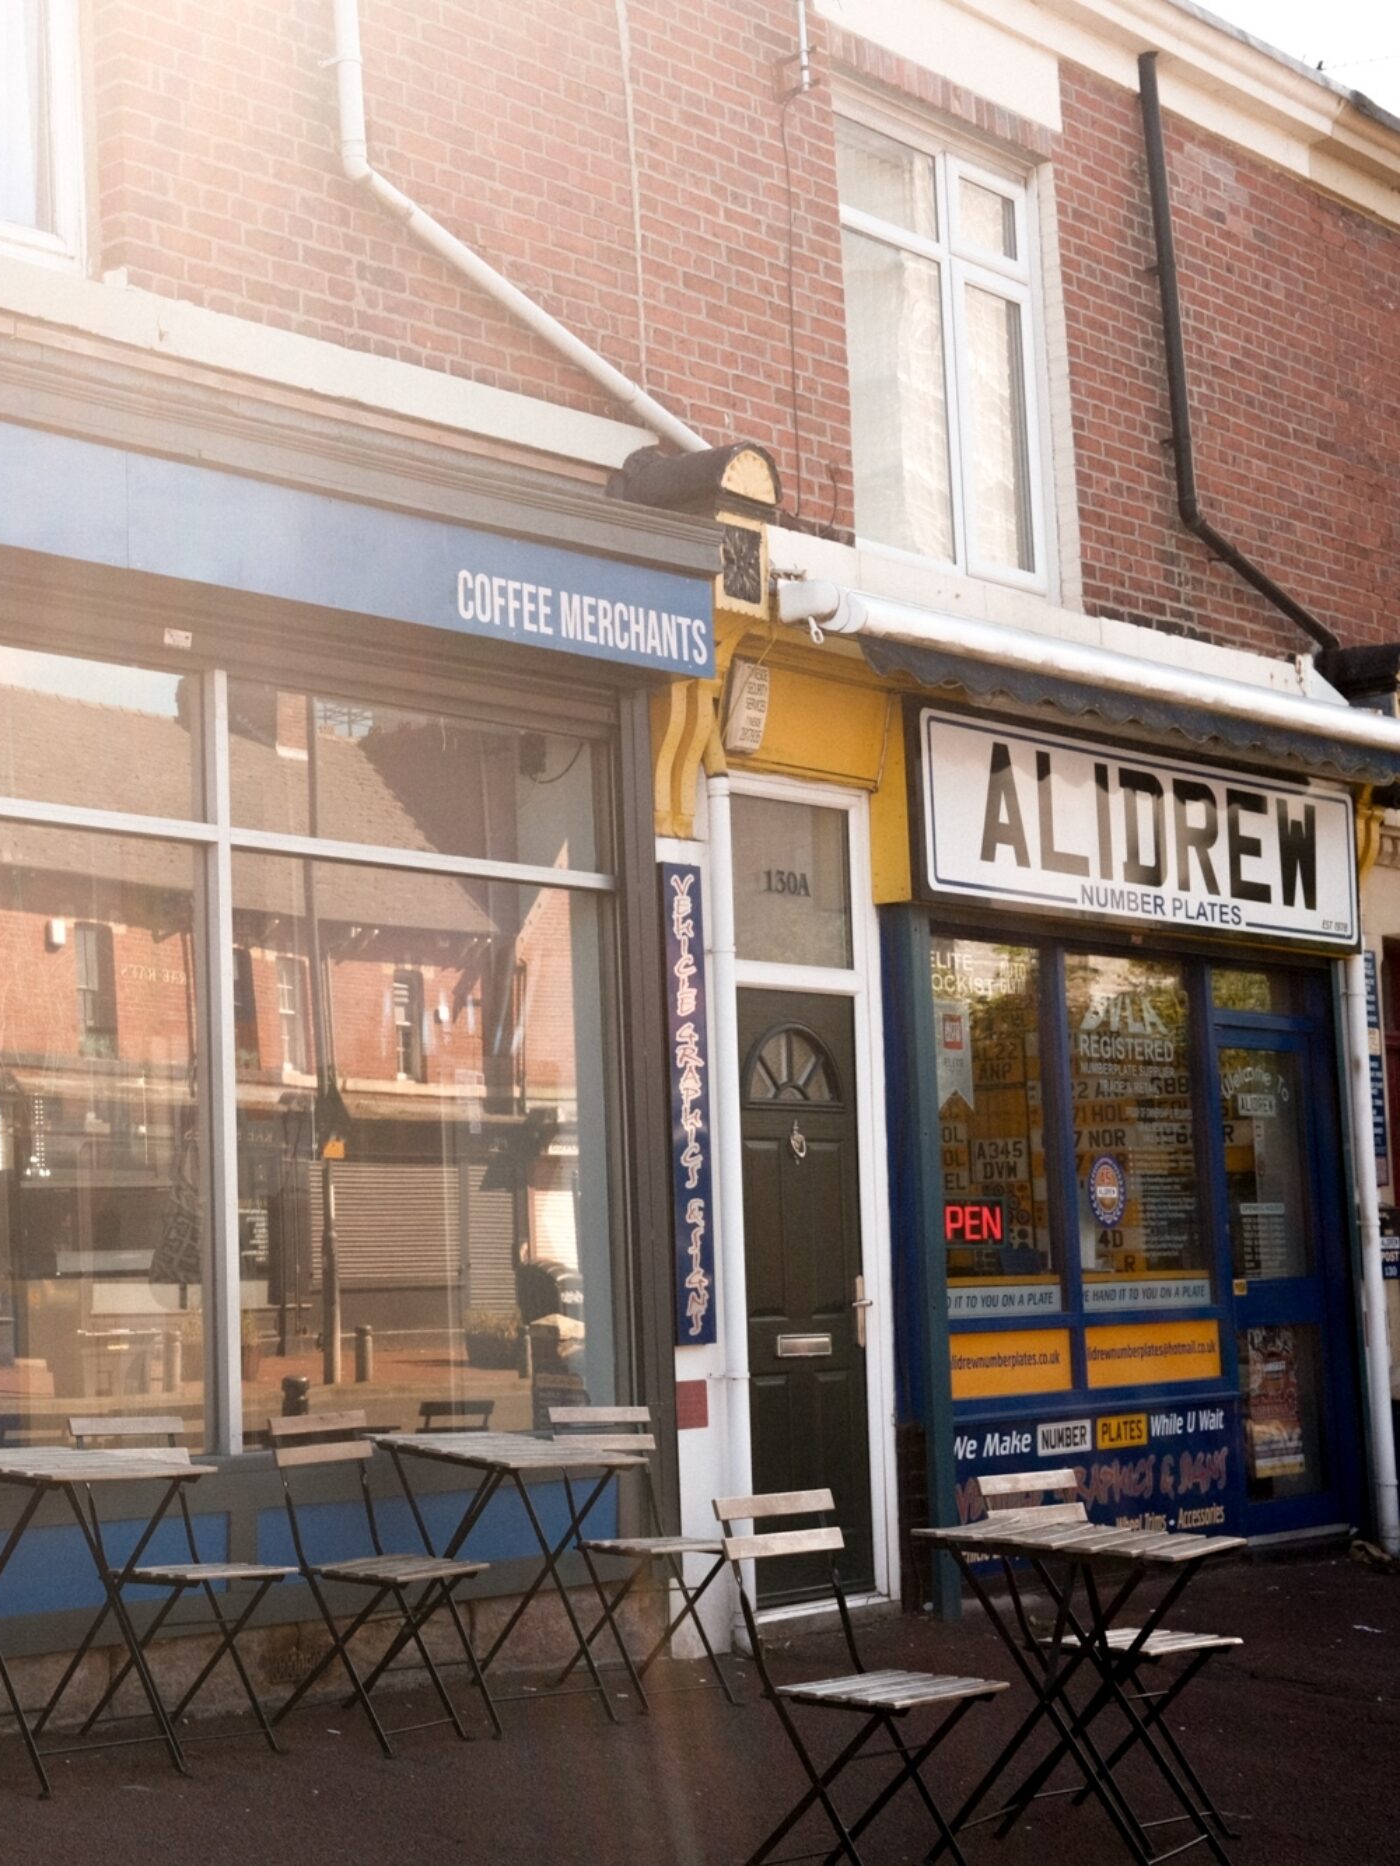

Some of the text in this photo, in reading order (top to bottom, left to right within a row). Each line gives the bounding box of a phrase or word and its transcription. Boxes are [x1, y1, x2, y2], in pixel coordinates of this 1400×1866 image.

[457, 568, 709, 666] COFFEE MERCHANTS
[980, 740, 1317, 911] ALIDREW
[762, 868, 812, 898] 130A
[1080, 884, 1243, 926] NUMBER PLATES
[931, 973, 995, 999] OCKIST
[1079, 1033, 1175, 1063] REGISTERED
[977, 1142, 1023, 1161] A345
[1089, 1127, 1126, 1149] NOR
[983, 1161, 1018, 1180] DVW
[944, 1205, 1003, 1241] PEN
[954, 1296, 963, 1310] IT
[965, 1295, 978, 1310] TO
[980, 1293, 1000, 1309] YOU
[1002, 1293, 1015, 1308] ON
[1017, 1294, 1025, 1307] A
[1026, 1290, 1054, 1306] PLATE
[1092, 1288, 1117, 1303] HAND
[1118, 1288, 1127, 1302] IT
[1128, 1288, 1140, 1302] TO
[1141, 1286, 1158, 1301] YOU
[1159, 1286, 1173, 1299] ON
[1174, 1286, 1181, 1299] A
[1182, 1284, 1206, 1298] PLATE
[954, 1408, 1225, 1460] We Make NUMBER PLATES While U Wait
[1055, 1453, 1156, 1512] RAPHICS
[1177, 1502, 1225, 1529] Accessories
